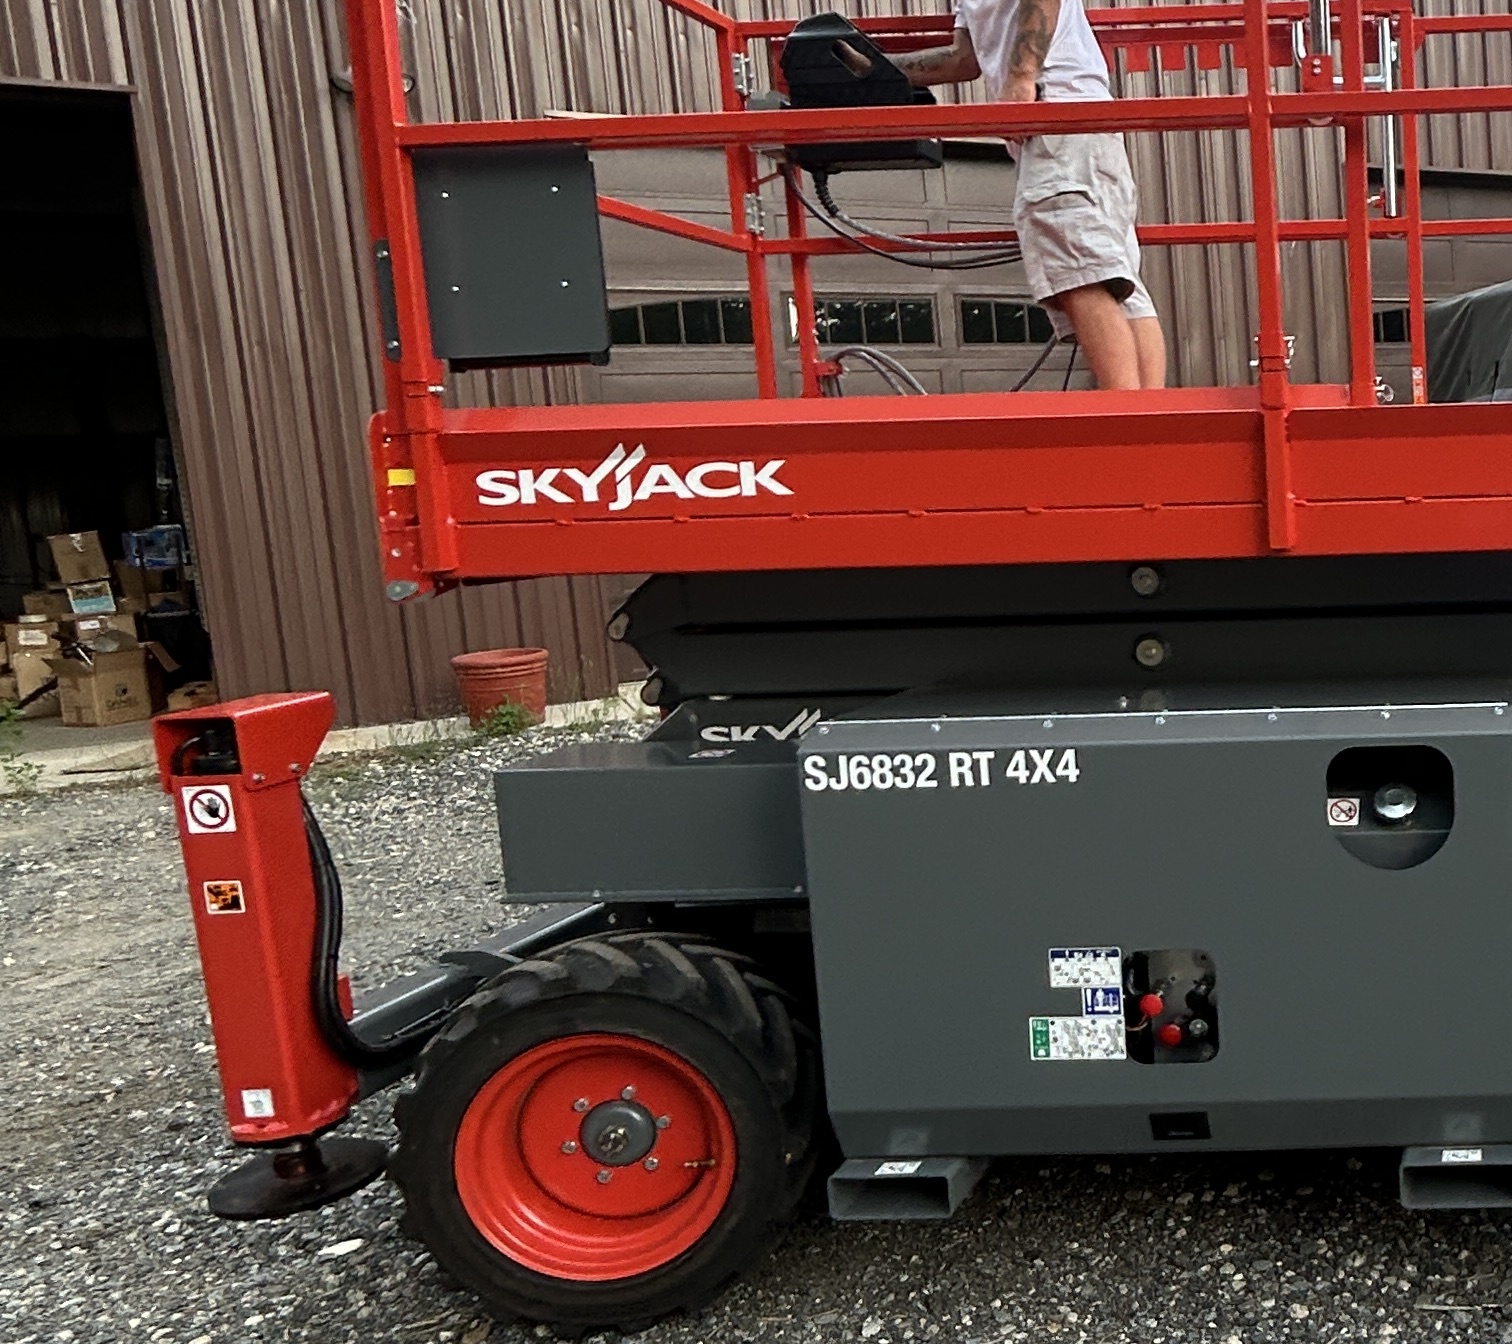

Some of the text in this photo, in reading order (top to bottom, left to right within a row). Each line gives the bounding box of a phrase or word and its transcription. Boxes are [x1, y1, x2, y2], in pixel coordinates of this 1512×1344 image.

[475, 442, 795, 511] SKYJACK
[803, 748, 1080, 791] SJ6832 RT 4X4
